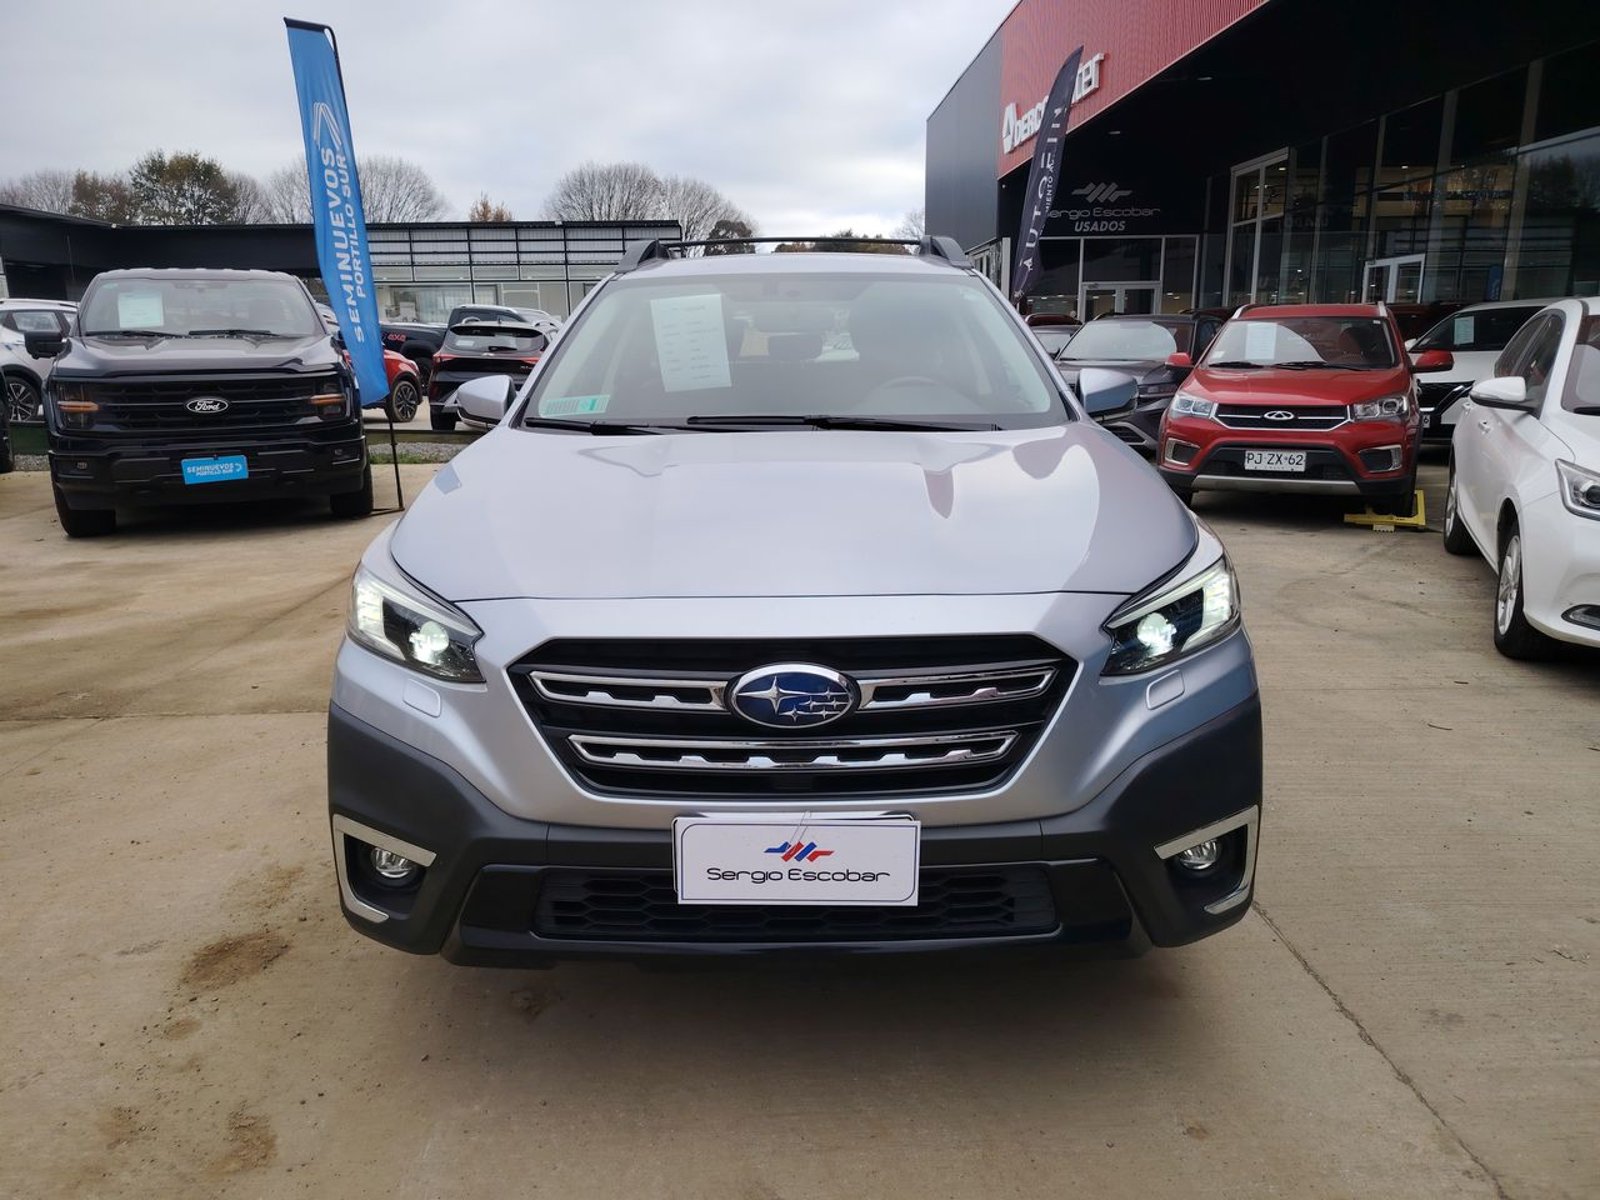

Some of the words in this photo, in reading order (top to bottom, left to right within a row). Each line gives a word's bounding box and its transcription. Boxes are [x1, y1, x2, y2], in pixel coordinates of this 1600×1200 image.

[336, 154, 352, 199] SUR
[1093, 206, 1161, 217] Escobar
[1074, 220, 1126, 232] USADOS
[320, 148, 365, 343] SEMINUEVOS
[344, 202, 368, 298] PORTILLO
[194, 400, 221, 411] Ford
[186, 462, 235, 474] SEMINUEVOS
[706, 867, 783, 884] Sergio
[788, 868, 891, 883] Escobar
